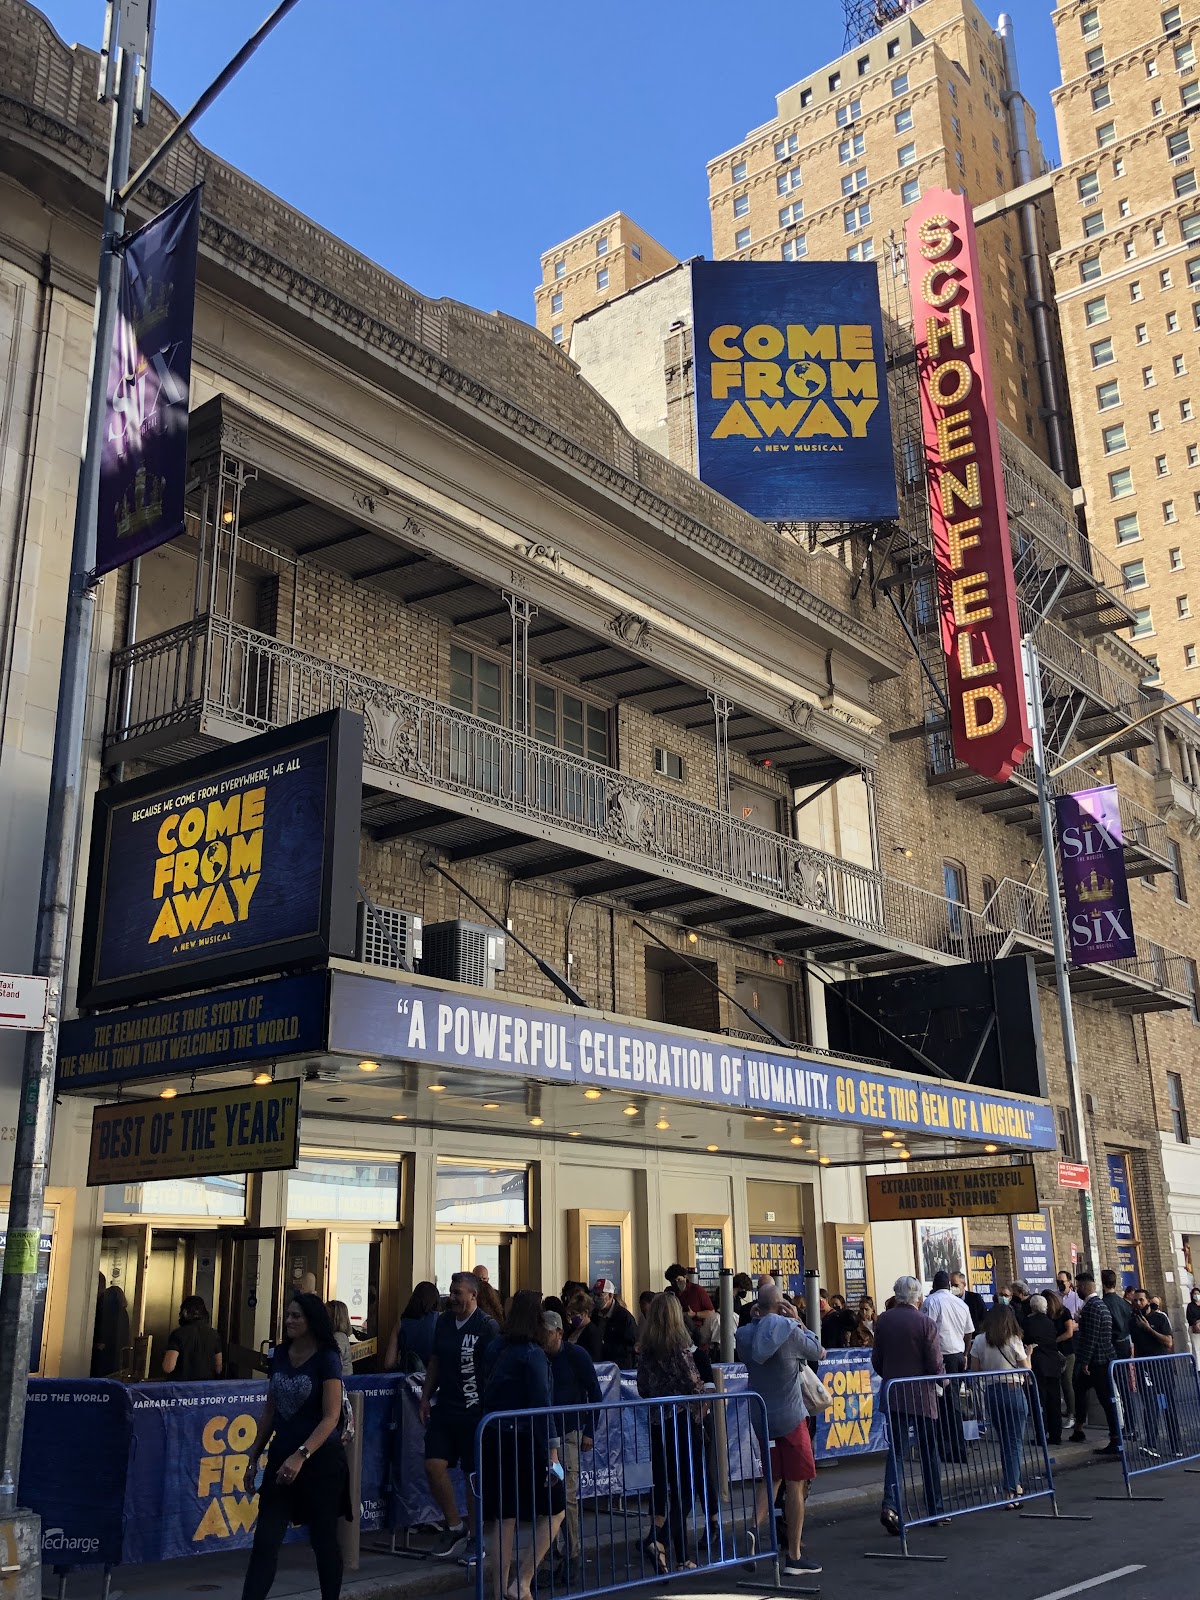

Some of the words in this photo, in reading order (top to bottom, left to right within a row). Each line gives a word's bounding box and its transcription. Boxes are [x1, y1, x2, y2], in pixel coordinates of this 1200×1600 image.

[708, 324, 874, 361] COME
[710, 360, 879, 399] FROM
[710, 399, 879, 439] AWAY
[794, 444, 843, 452] MUSICAL
[918, 214, 1007, 740] SCHOENFELD
[132, 801, 162, 823] BECAUSE
[163, 798, 174, 811] WE
[175, 791, 197, 808] COME
[197, 785, 219, 801] FROM
[220, 770, 270, 794] EVERYWHERE,
[272, 765, 285, 777] WE
[286, 758, 301, 773] ALL
[157, 786, 267, 855] COME
[1062, 818, 1120, 859] SIX
[152, 829, 264, 900] FROM
[148, 873, 261, 944] AWAY
[180, 939, 197, 952] NEW
[198, 932, 231, 948] MUSICAL
[1071, 908, 1131, 947] SIX
[94, 1024, 112, 1047] THE
[113, 1011, 179, 1044] REMARKABLE
[182, 1006, 209, 1031] TRUE
[210, 997, 247, 1026] STORY
[248, 995, 264, 1019] OF
[60, 1055, 77, 1078] THE
[78, 1050, 109, 1075] SMALL
[112, 1044, 140, 1070] TOWN
[142, 1040, 169, 1065] THAT
[169, 1029, 230, 1060] WELCOMED
[233, 1024, 254, 1048] THE
[256, 1016, 301, 1044] WORLD.
[437, 1003, 572, 1072] POWERFUL
[578, 1029, 714, 1093] CELEBRATION
[720, 1054, 742, 1097] OF
[747, 1059, 832, 1110] HUMANITY.
[835, 1075, 856, 1114] GO
[860, 1080, 887, 1119] SEE
[888, 1086, 919, 1124] THIS
[921, 1092, 950, 1128] GEM
[952, 1097, 967, 1130] OF
[969, 1102, 979, 1131] A
[150, 1112, 175, 1155] OF
[181, 1106, 218, 1152] THE
[899, 1195, 918, 1210] AND
[760, 1243, 769, 1258] OF
[769, 1243, 781, 1259] THE
[782, 1244, 797, 1259] BEST
[778, 1260, 799, 1275] PIECES
[461, 1333, 479, 1347] NY
[461, 1347, 475, 1373] NEW
[51, 1394, 70, 1402] THE
[73, 1394, 110, 1402] WORLD
[177, 1397, 199, 1407] TRUE
[200, 1396, 226, 1406] STORY
[227, 1395, 239, 1404] OF
[240, 1395, 255, 1403] THE
[462, 1375, 480, 1408] YORK
[823, 1370, 872, 1396] COME
[825, 1419, 872, 1450] AWAY
[364, 1500, 377, 1509] The
